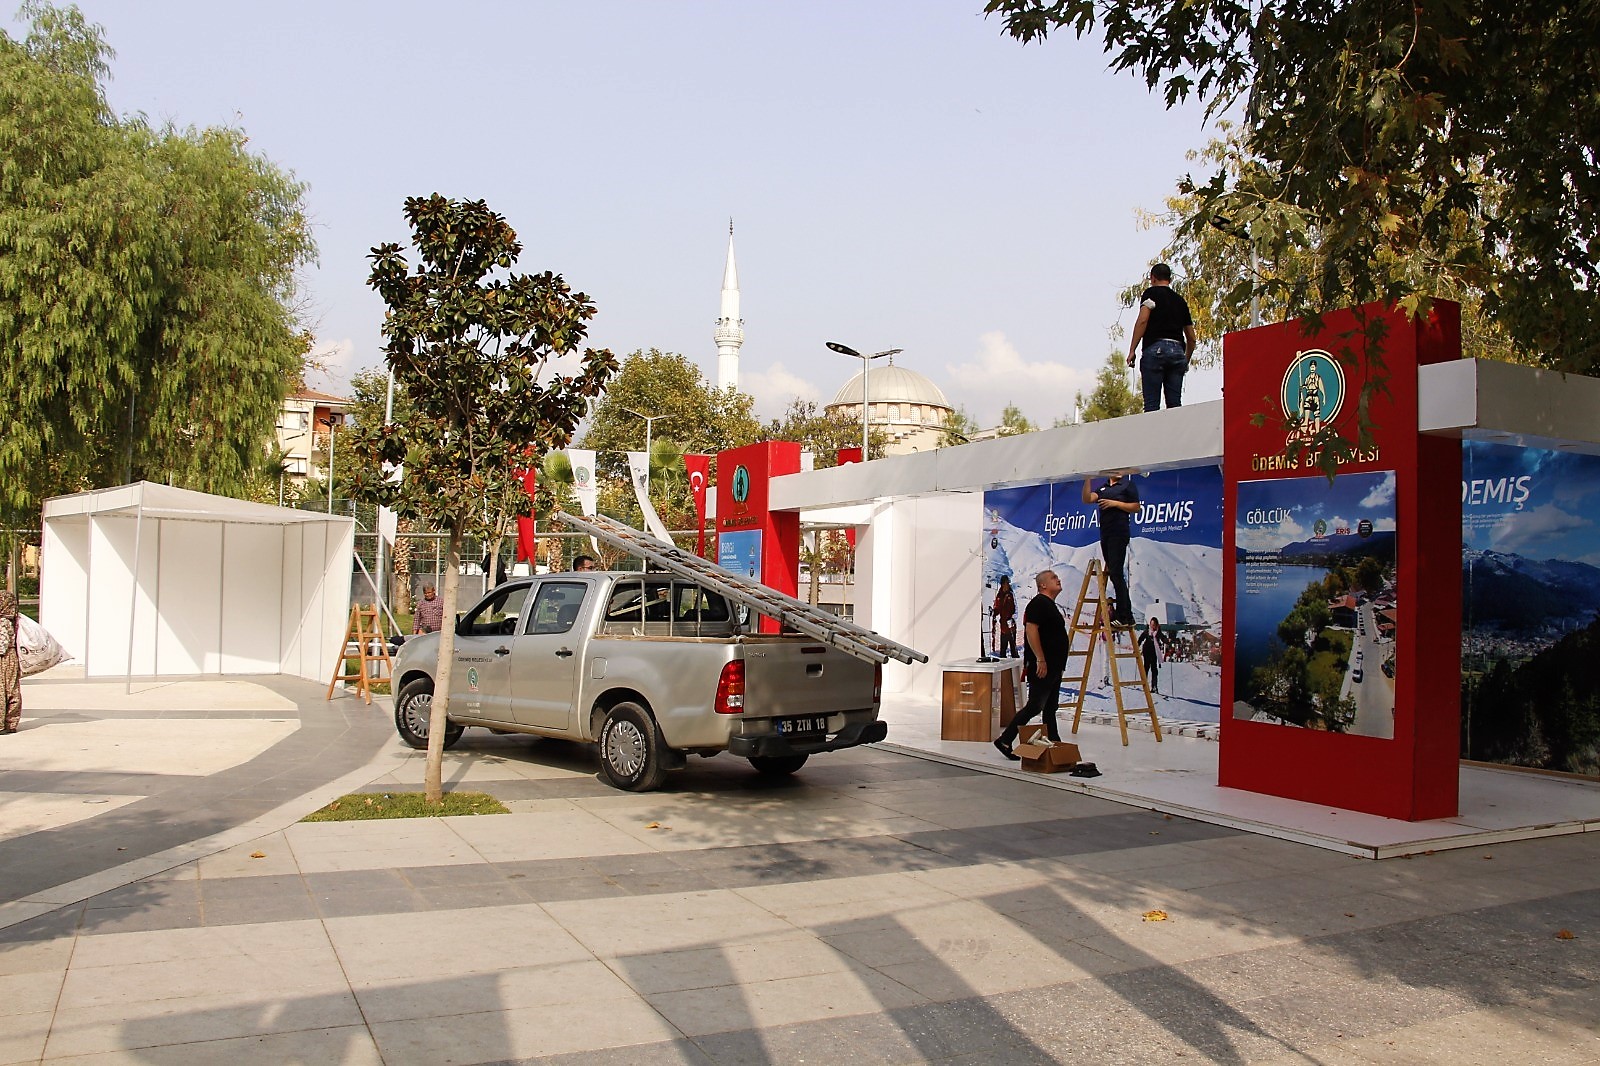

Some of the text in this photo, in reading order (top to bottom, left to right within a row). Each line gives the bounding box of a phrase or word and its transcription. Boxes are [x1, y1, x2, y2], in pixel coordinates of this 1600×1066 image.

[1045, 510, 1086, 537] Ege'nin
[1246, 508, 1291, 524] GÖLCÜK
[781, 720, 793, 733] 35
